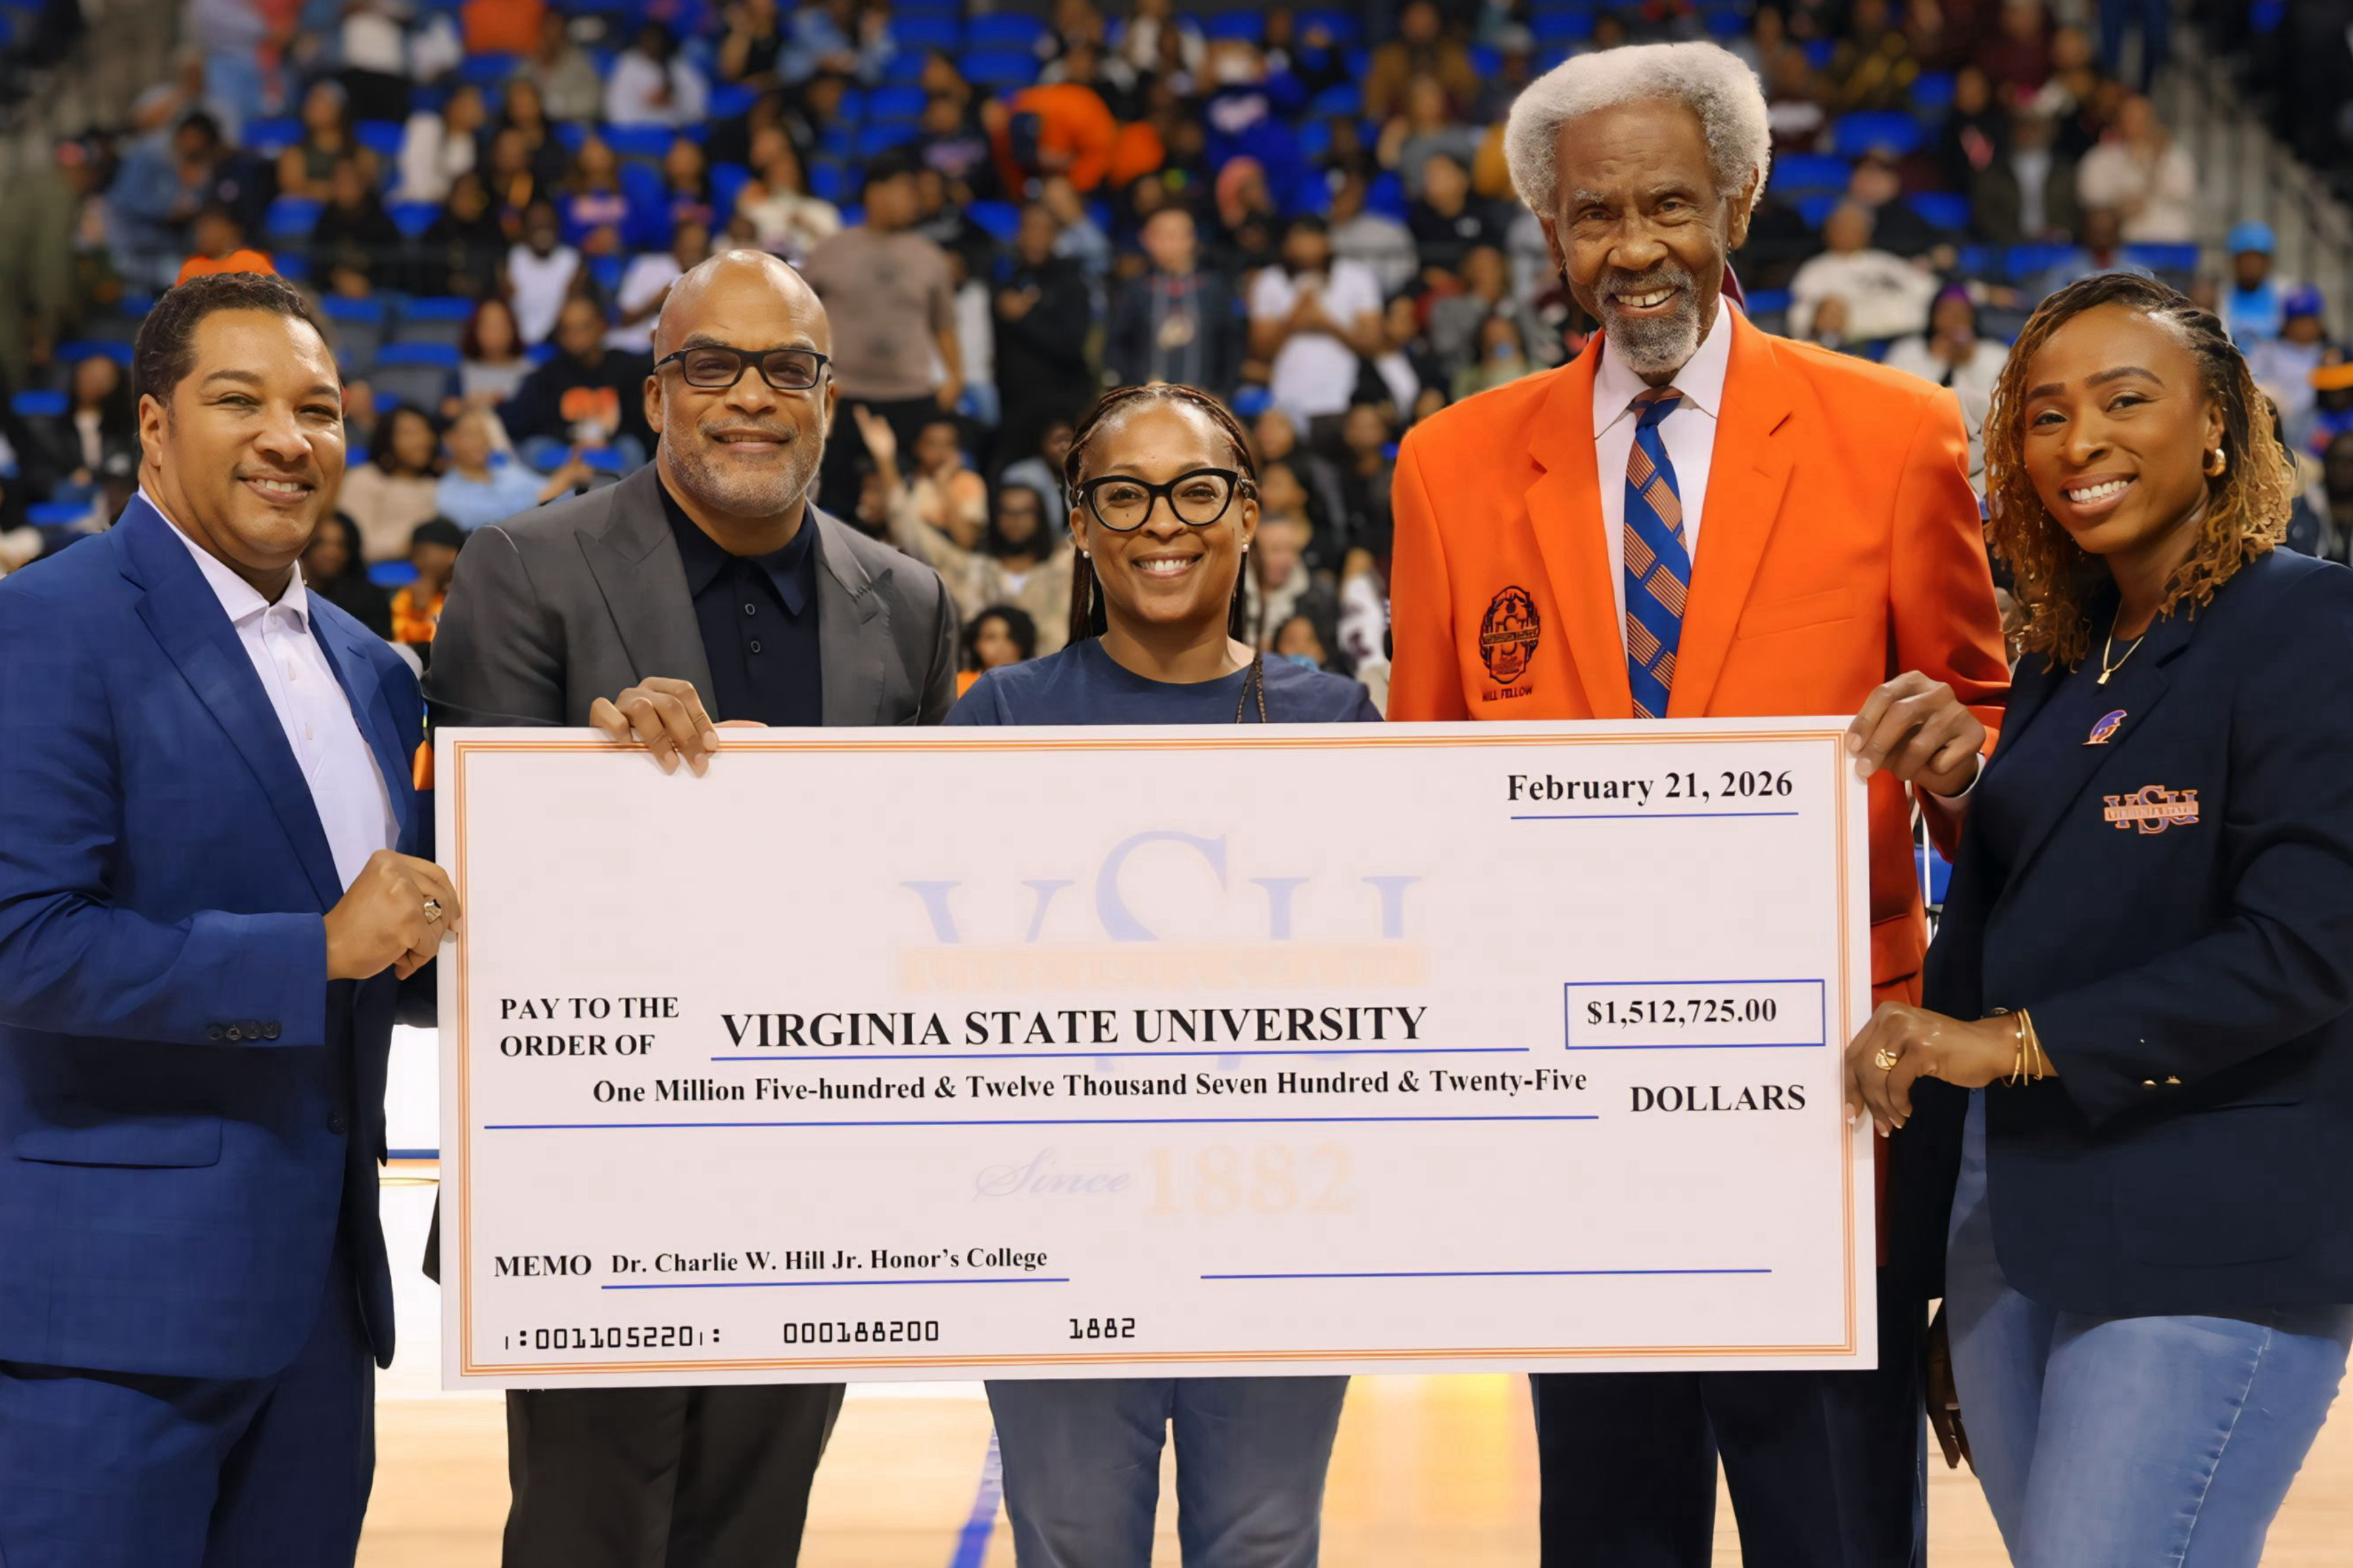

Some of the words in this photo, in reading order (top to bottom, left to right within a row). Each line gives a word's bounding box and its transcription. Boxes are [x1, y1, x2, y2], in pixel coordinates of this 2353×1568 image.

[1507, 774, 1655, 807] February
[1665, 772, 1710, 803] 21,
[1720, 770, 1793, 797] 2026
[2104, 785, 2200, 834] VSU
[500, 998, 561, 1020] PAY
[567, 997, 611, 1019] TO
[617, 996, 680, 1018] THE
[1586, 998, 1778, 1028] $1,512,725.00
[720, 1012, 952, 1048] VIRGINIA
[965, 1009, 1119, 1046] STATE
[1133, 1005, 1428, 1044] UNIVERSITY
[500, 1034, 609, 1057] ORDER
[614, 1033, 656, 1055] OF
[592, 1079, 646, 1103] One
[655, 1078, 745, 1102] Million
[755, 1076, 926, 1101] Five-hundred
[934, 1075, 957, 1099] &
[965, 1074, 1055, 1098] Twelve
[1062, 1072, 1187, 1097] Thousand
[1195, 1072, 1268, 1095] Seven
[1277, 1070, 1389, 1094] Hundred
[1397, 1070, 1421, 1093] &
[1429, 1068, 1588, 1097] Twenty-Five
[1630, 1084, 1807, 1112] DOLLARS
[971, 1145, 1133, 1204] Since
[1144, 1144, 1355, 1217] 1882
[494, 1254, 592, 1277] MEMO
[611, 1254, 647, 1273] Dr.
[654, 1252, 738, 1273] Charlie
[744, 1251, 777, 1271] W.
[785, 1250, 826, 1270] Hill
[831, 1250, 863, 1270] Jr.
[966, 1247, 1048, 1272] College
[783, 1320, 939, 1344] 000188200
[1068, 1316, 1136, 1340] 1882
